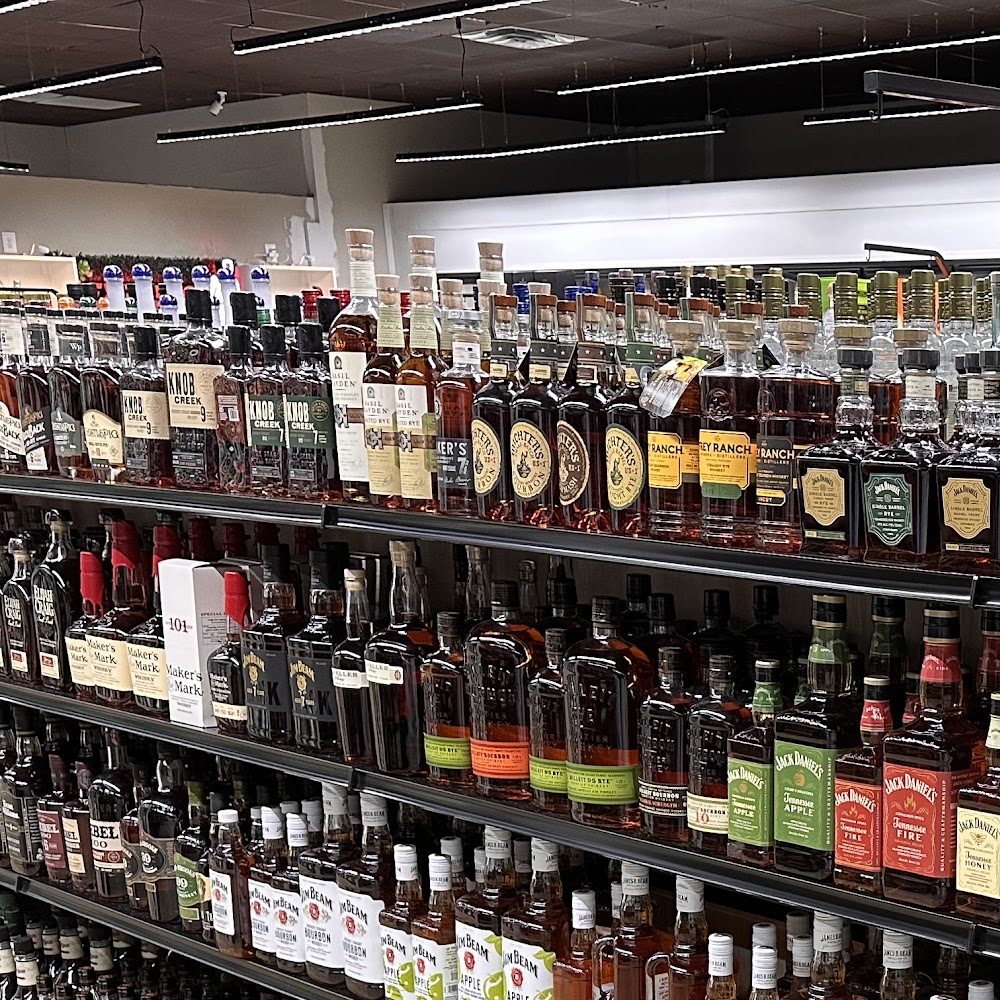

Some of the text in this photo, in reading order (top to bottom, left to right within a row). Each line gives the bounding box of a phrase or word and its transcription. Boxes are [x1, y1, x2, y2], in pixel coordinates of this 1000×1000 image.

[168, 372, 195, 395] KNOB
[124, 396, 142, 414] KNOB
[174, 396, 201, 405] CREEK
[201, 406, 206, 422] 9
[250, 401, 275, 421] KNOB
[287, 402, 309, 422] KNOB
[147, 422, 152, 435] 9
[291, 422, 315, 430] CREEK
[313, 430, 318, 445] 7
[651, 444, 683, 455] RANCH
[714, 443, 751, 454] RANCH
[760, 449, 795, 460] RANCH
[35, 598, 54, 615] CRAIG
[168, 617, 188, 633] 101
[94, 653, 117, 664] Mark
[135, 660, 160, 673] Mark
[775, 750, 824, 780] JACK DANIEL'S
[885, 773, 938, 803] JACK DANIEL'S
[733, 808, 755, 818] APPLE
[784, 805, 814, 817] APPLE
[844, 832, 862, 841] FIRE
[896, 829, 922, 842] FIRE
[965, 860, 992, 871] HONEY
[514, 950, 538, 978] BEAM
[461, 973, 481, 991] APPLE
